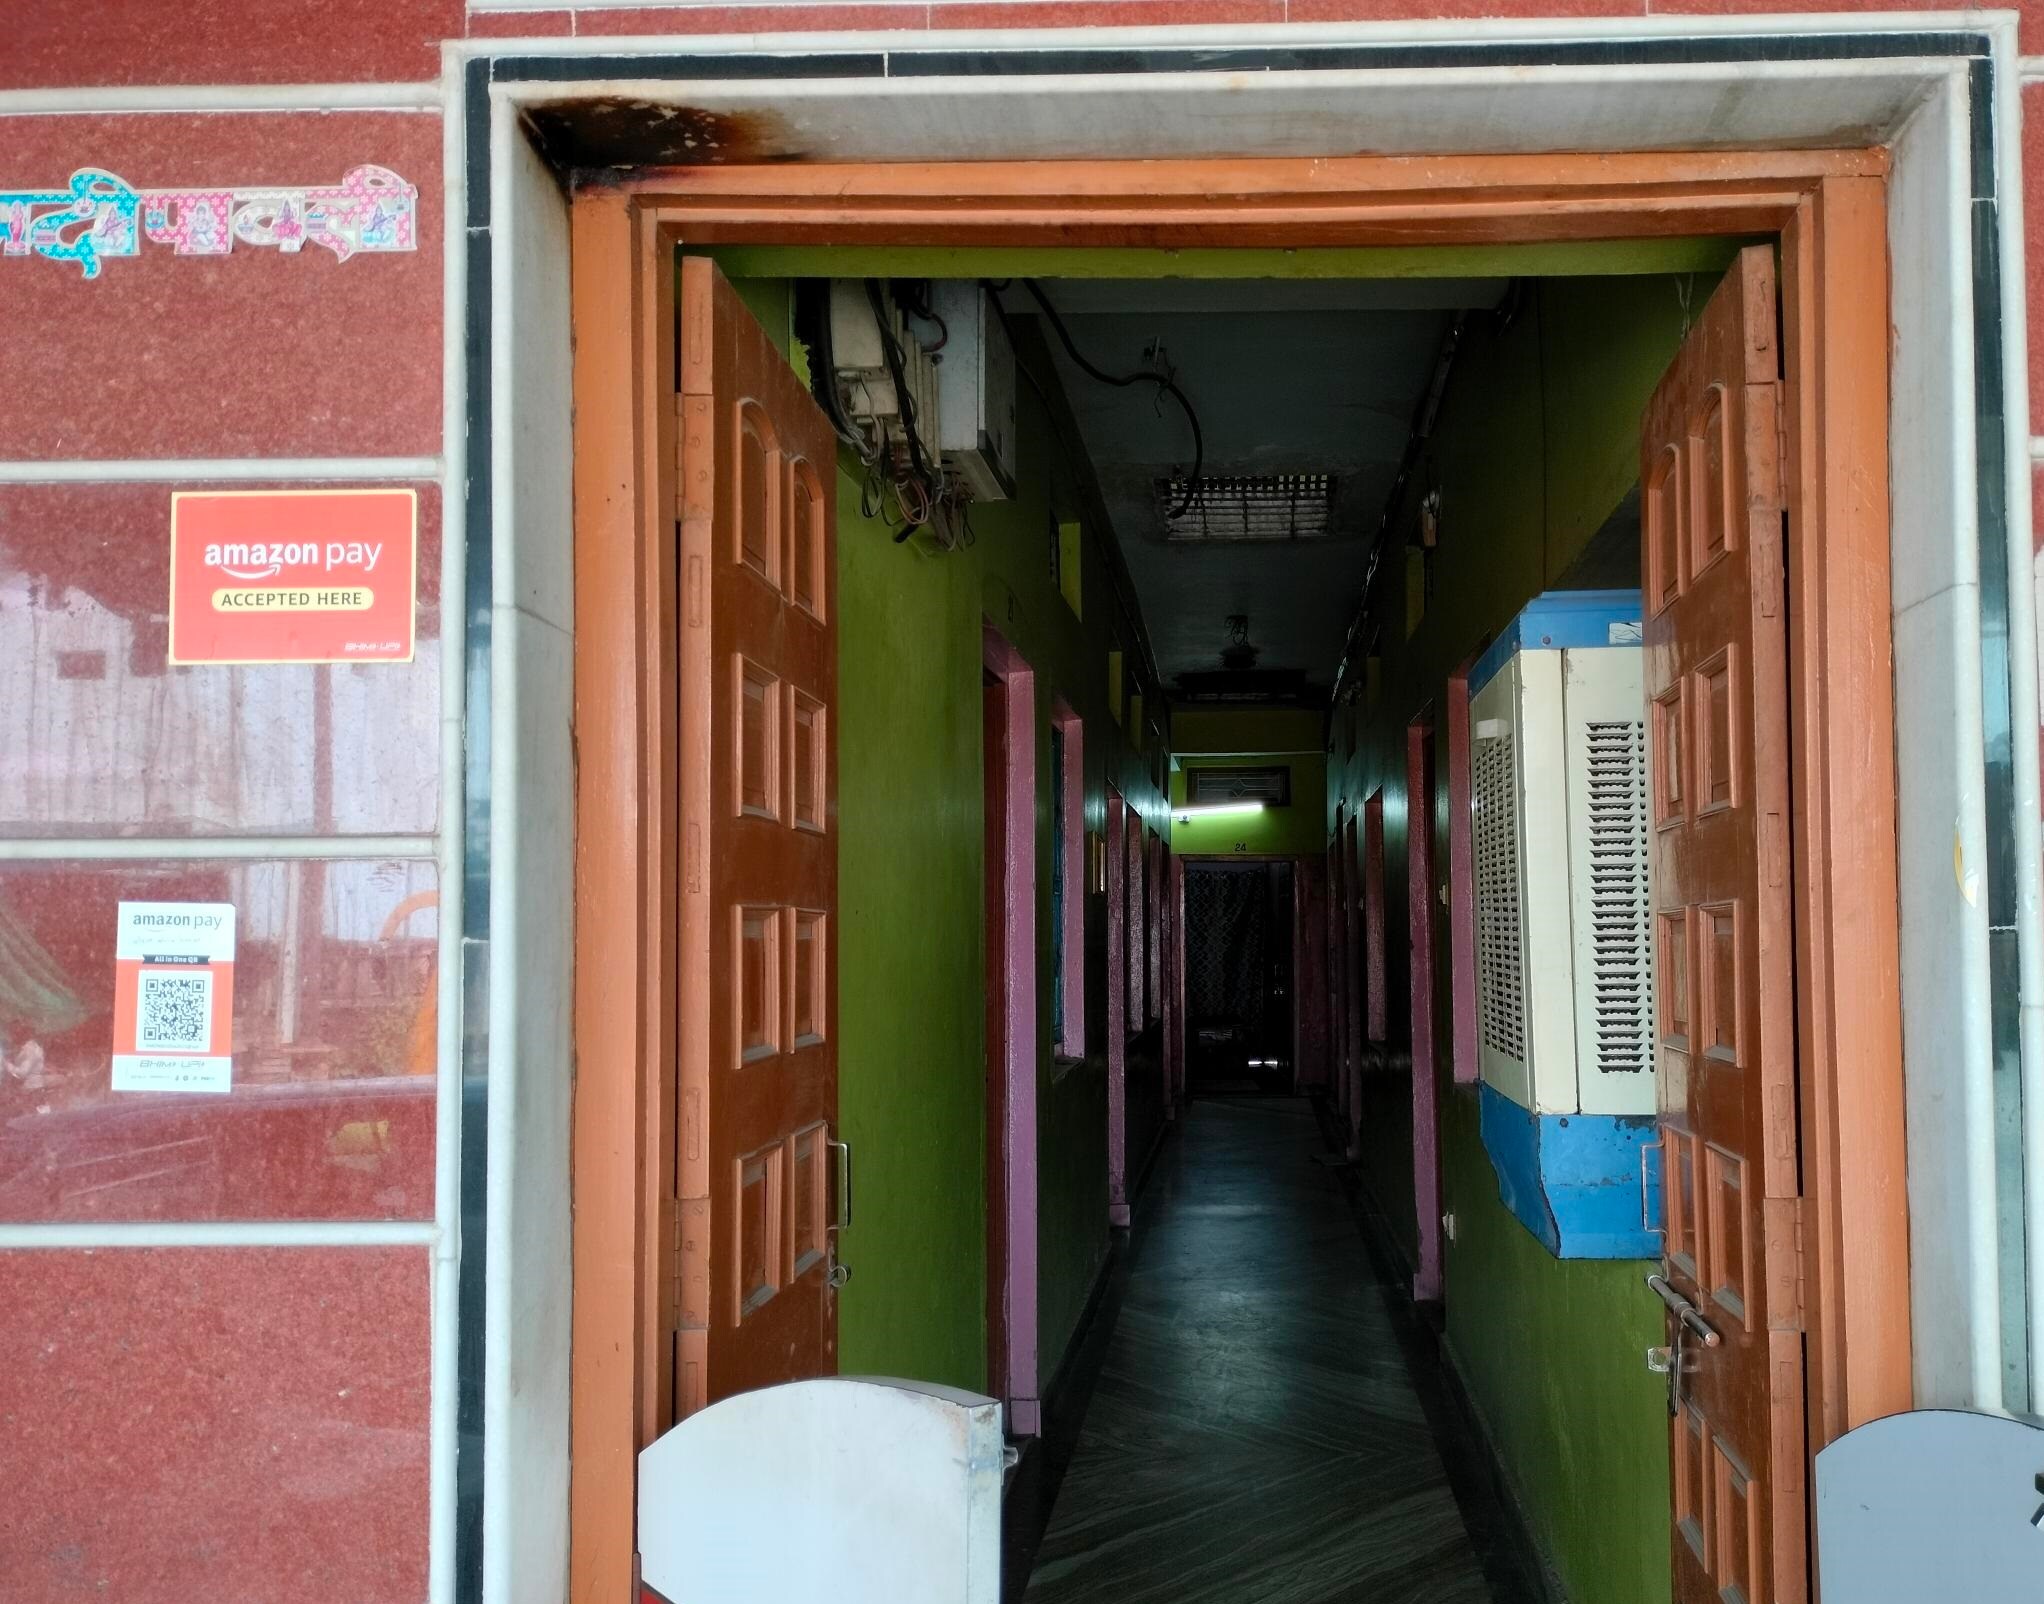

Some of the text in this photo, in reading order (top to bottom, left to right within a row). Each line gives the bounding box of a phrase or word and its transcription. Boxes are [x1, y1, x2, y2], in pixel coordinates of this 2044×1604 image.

[204, 542, 383, 571] amazon pay
[221, 591, 363, 607] ACCEPTED HERE
[1234, 843, 1247, 851] 24
[132, 913, 222, 931] amazon pay
